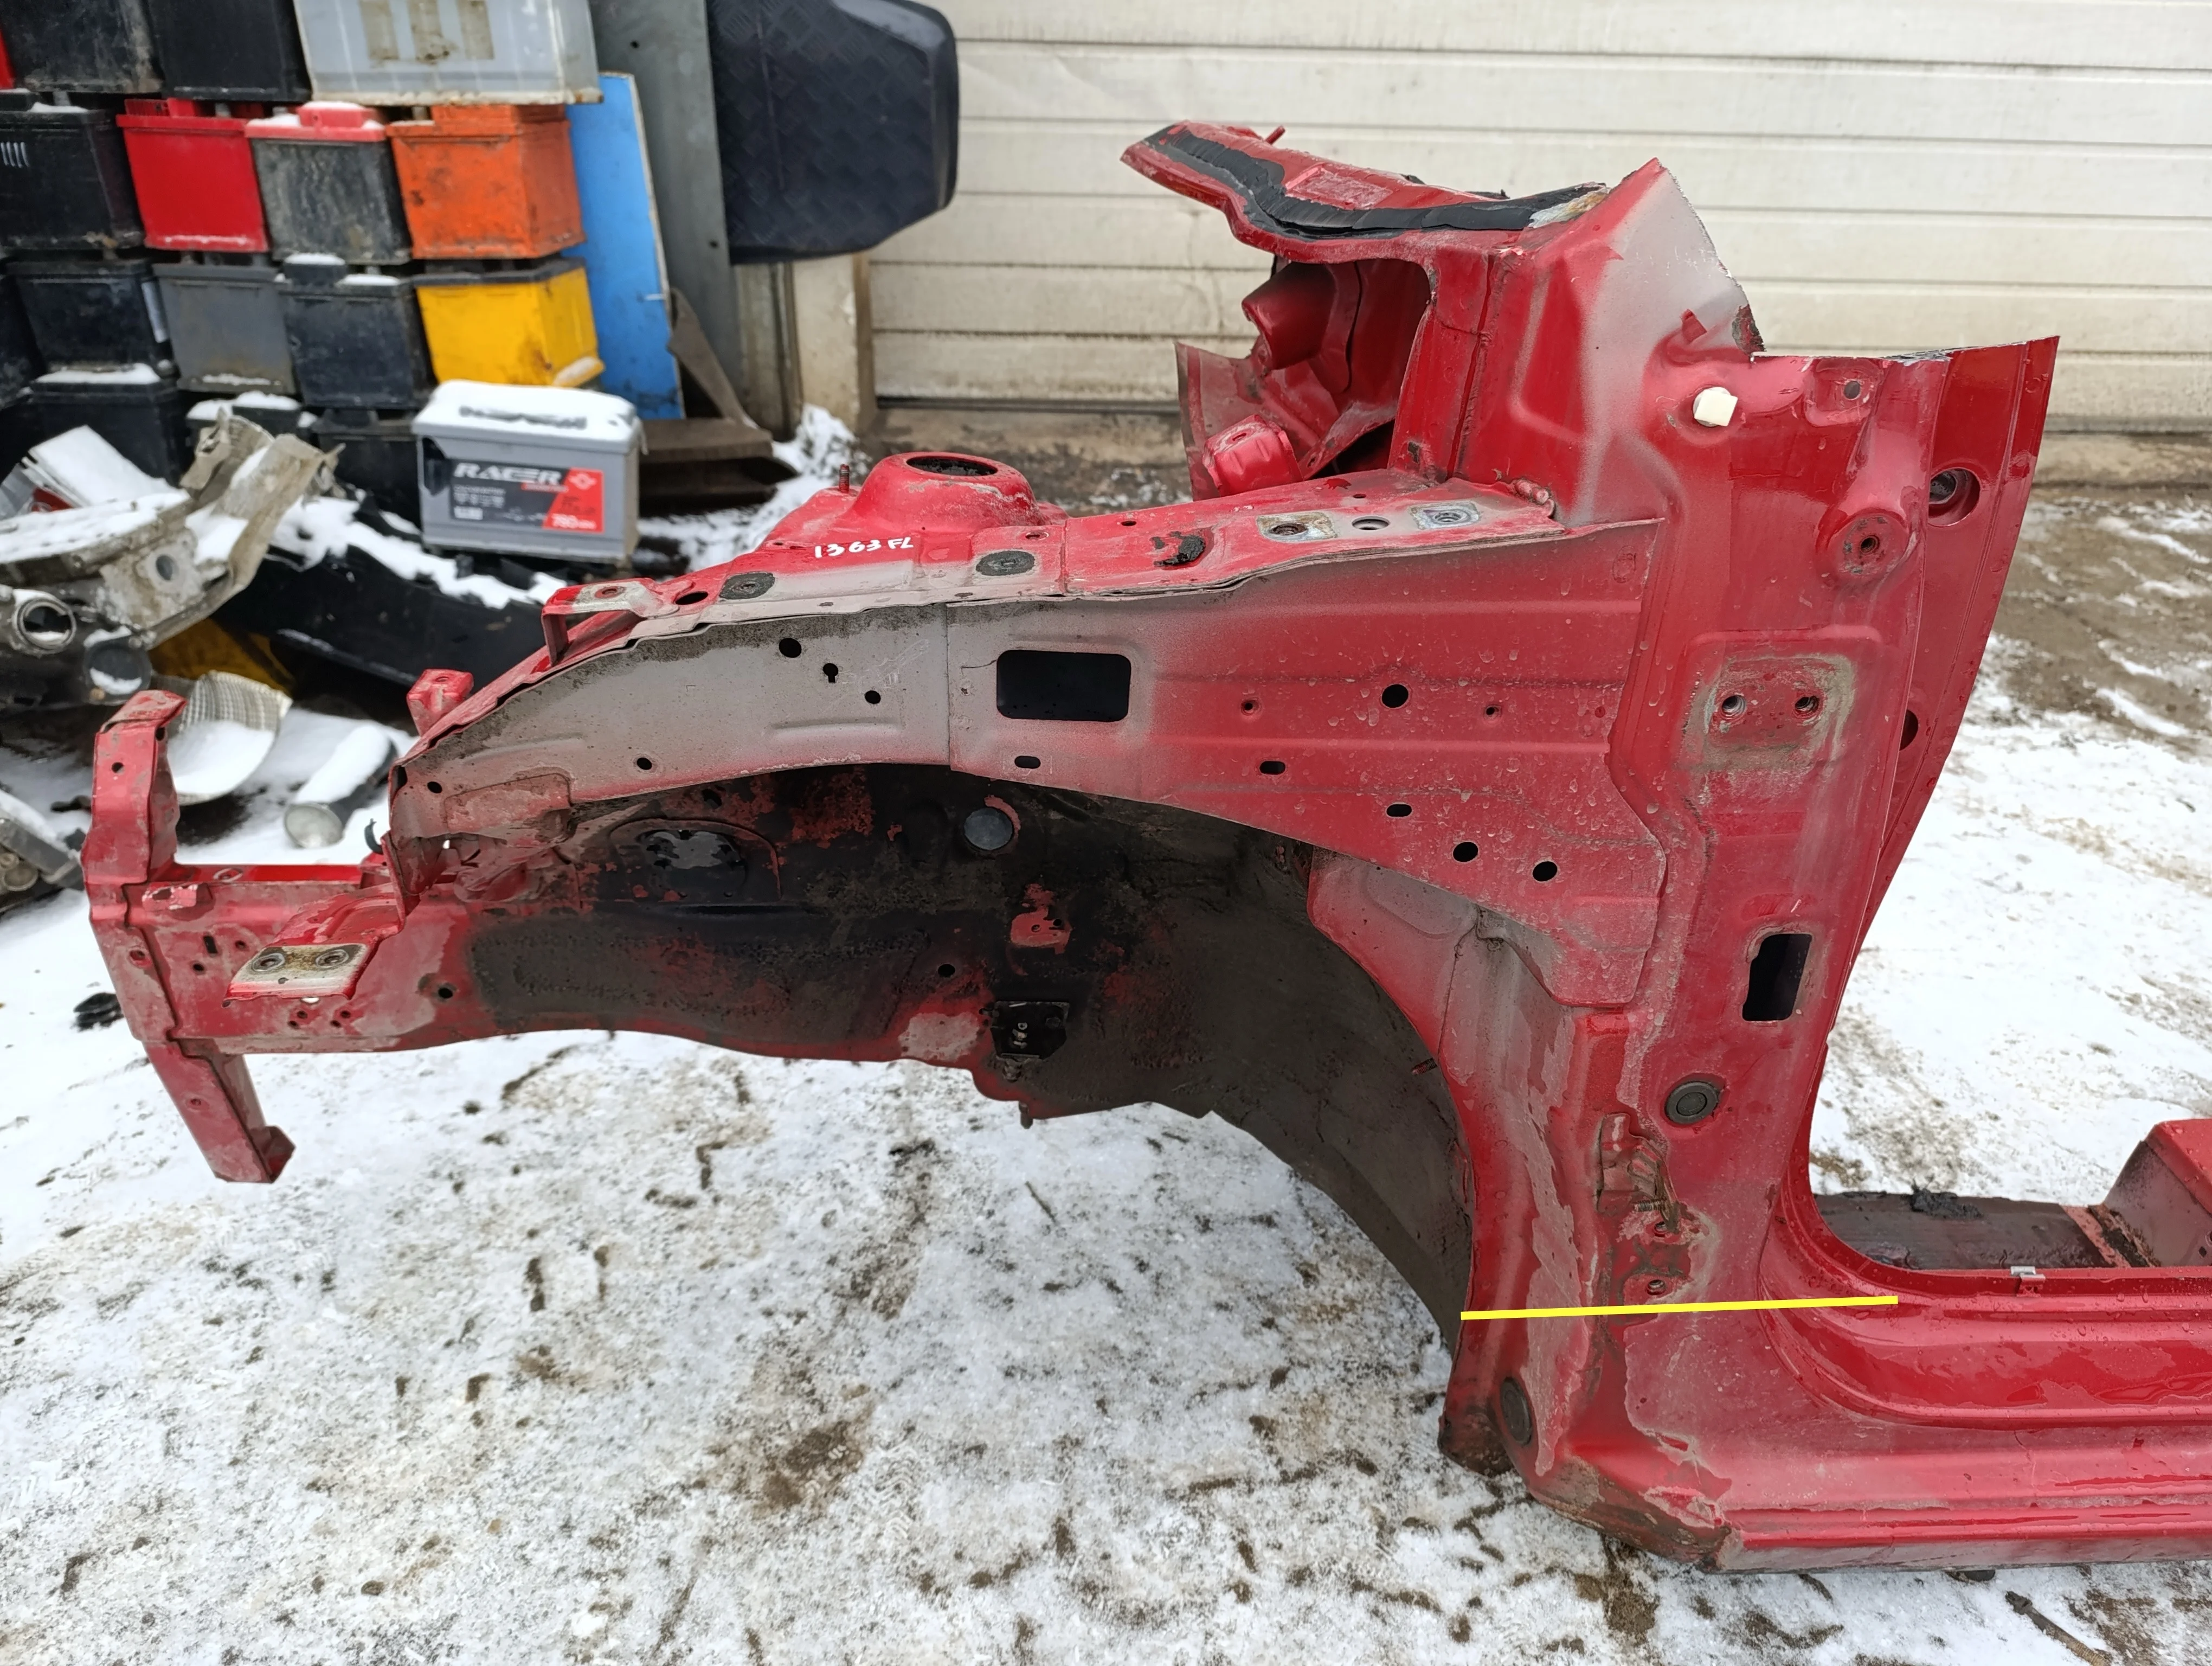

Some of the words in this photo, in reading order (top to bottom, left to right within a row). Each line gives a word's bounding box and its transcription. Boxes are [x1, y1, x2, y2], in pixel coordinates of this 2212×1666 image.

[454, 463, 562, 485] RACER
[814, 540, 882, 558] 1363
[887, 536, 914, 549] FL
